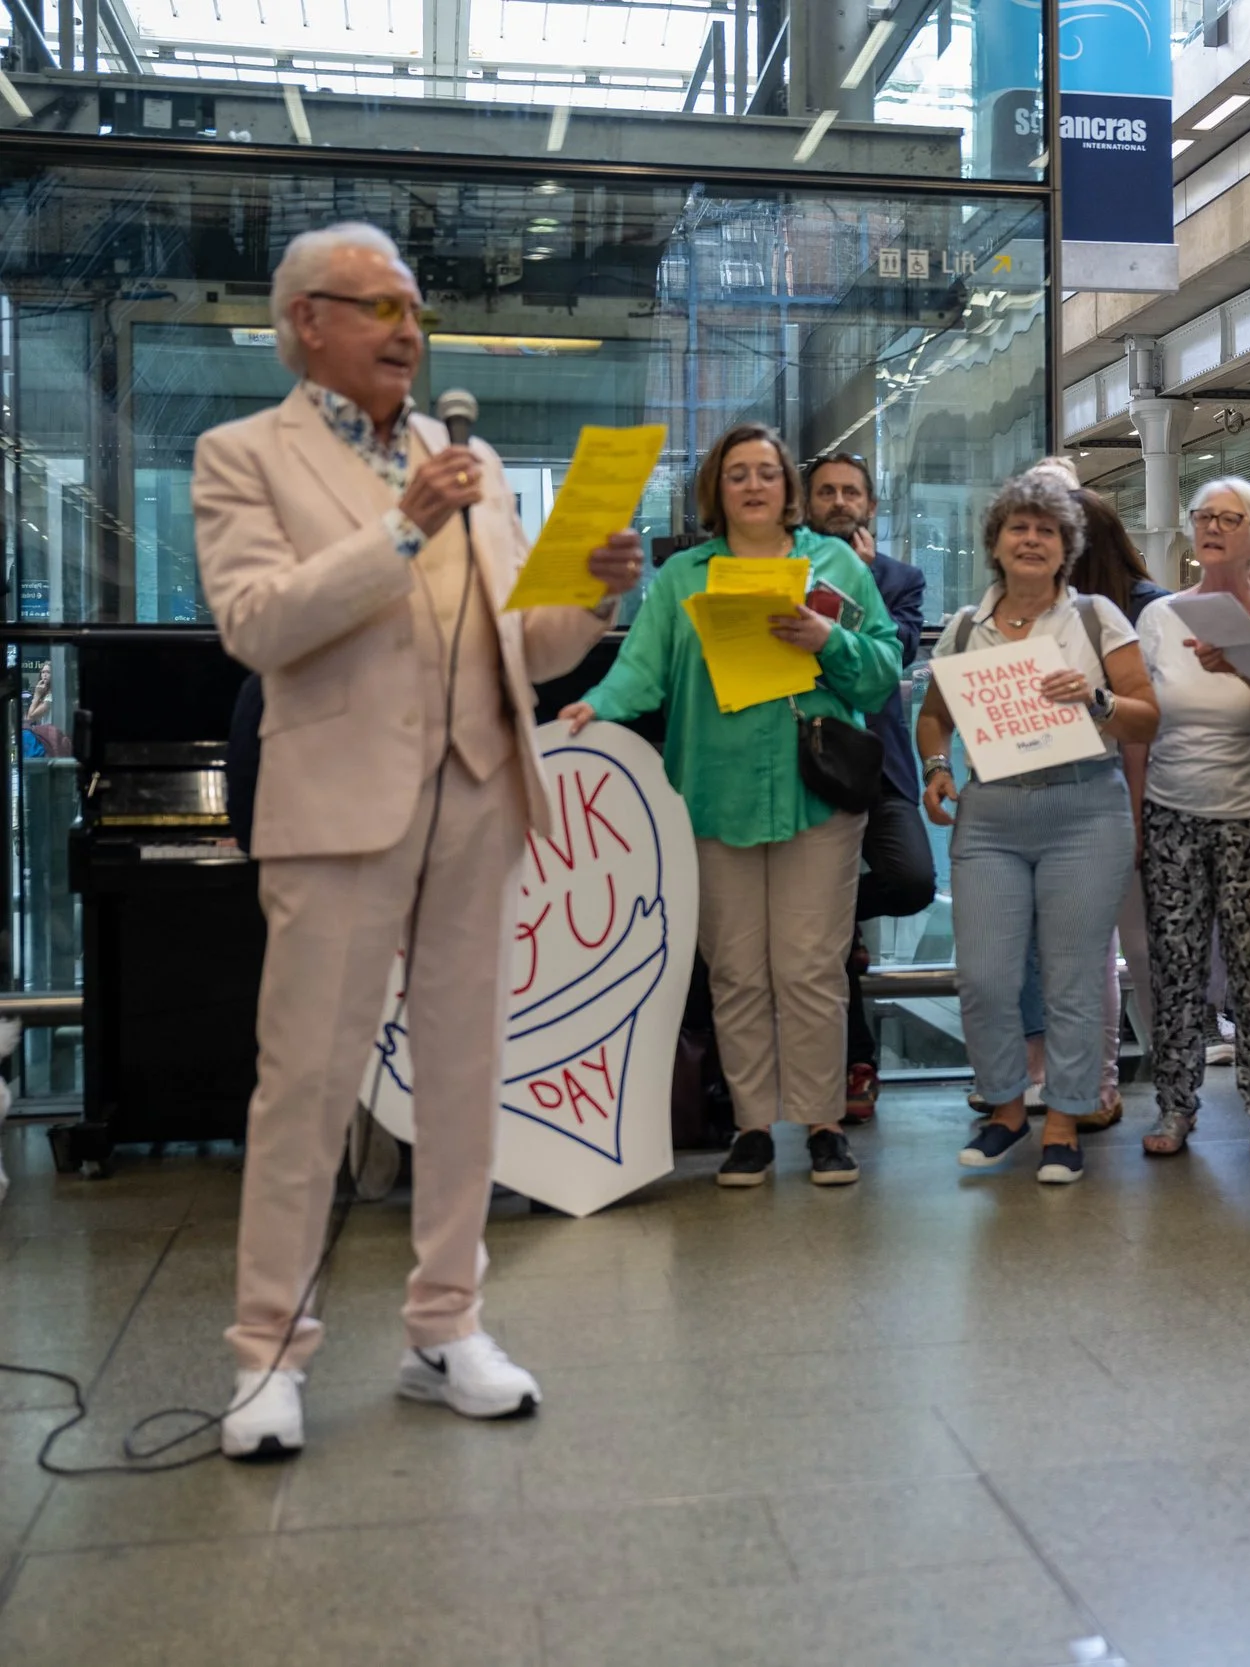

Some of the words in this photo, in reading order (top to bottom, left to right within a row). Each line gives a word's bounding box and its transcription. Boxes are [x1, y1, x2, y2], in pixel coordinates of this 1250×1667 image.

[1058, 115, 1148, 143] ancras
[1082, 142, 1147, 152] INTERNATIONAL
[942, 250, 977, 275] Lift
[962, 657, 1042, 688] THANK
[961, 683, 1012, 707] YOU
[1015, 676, 1045, 696] FO
[975, 727, 993, 746] A
[994, 704, 1084, 739] FRIEND!
[528, 1045, 616, 1124] DAY
